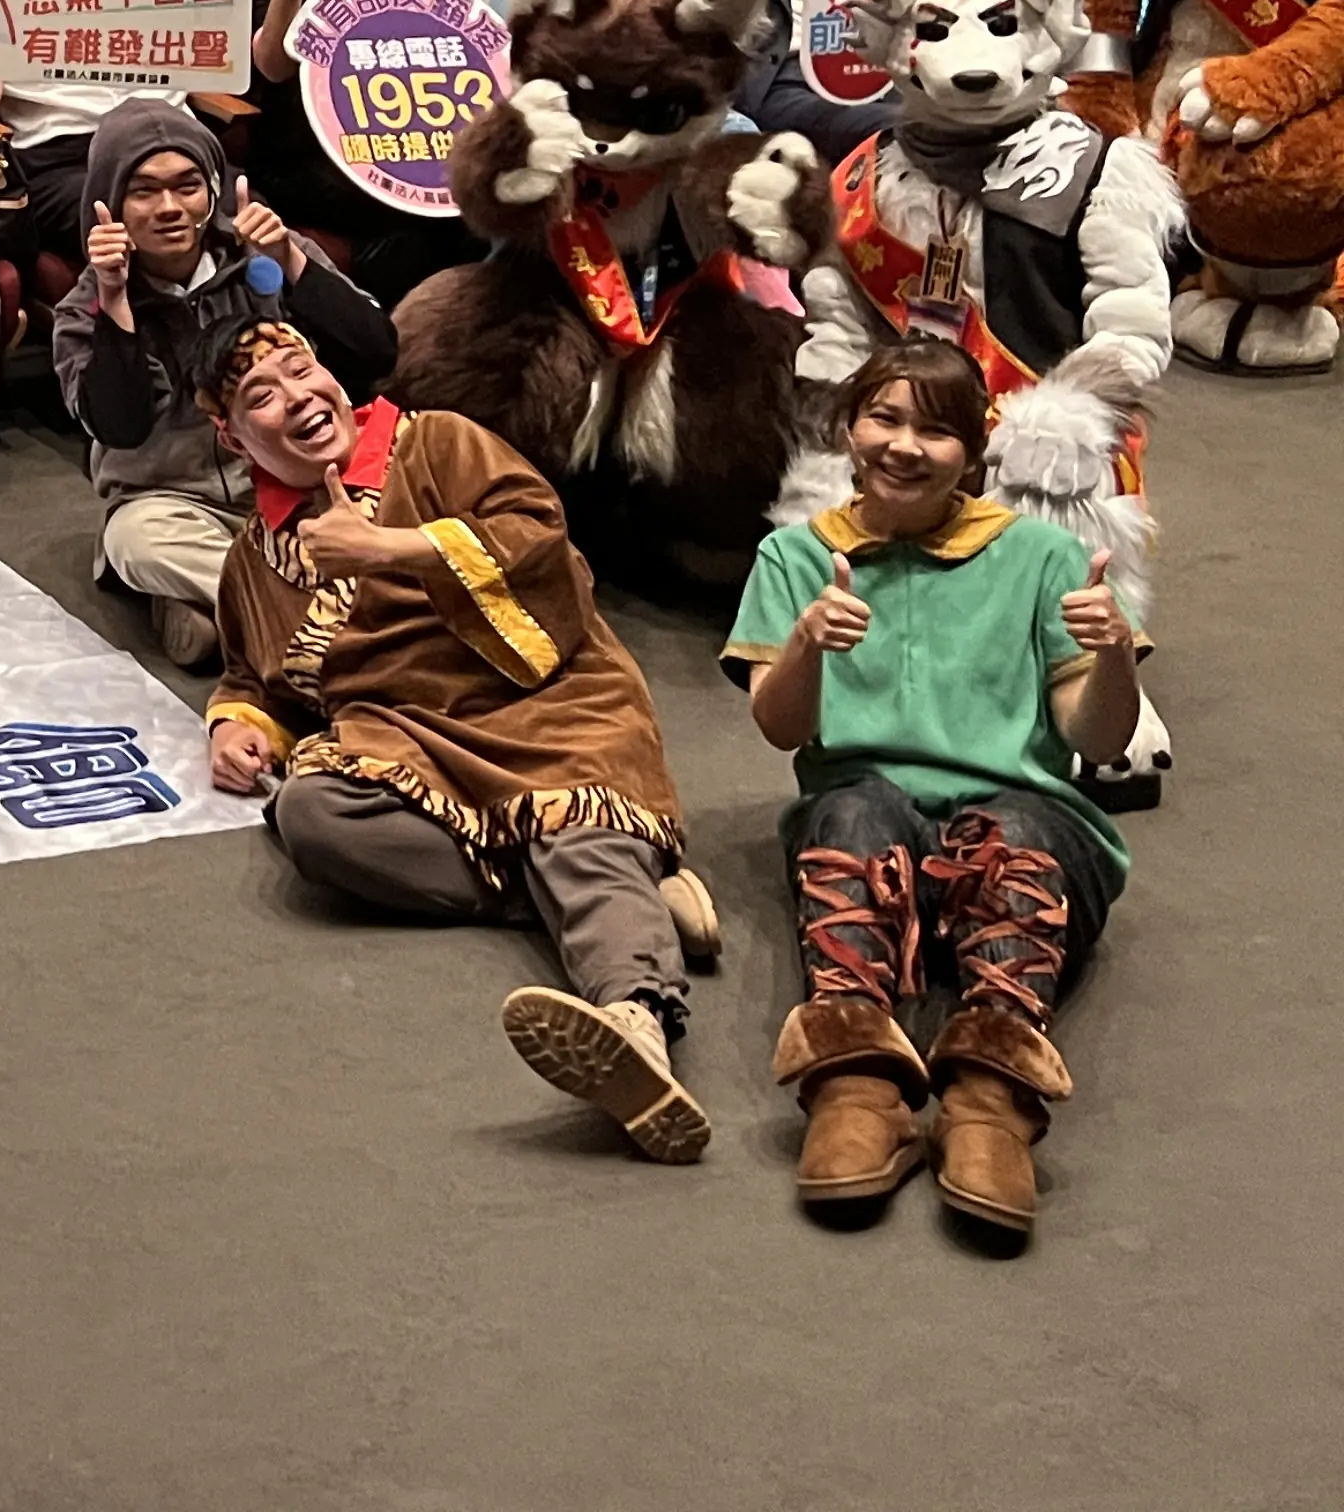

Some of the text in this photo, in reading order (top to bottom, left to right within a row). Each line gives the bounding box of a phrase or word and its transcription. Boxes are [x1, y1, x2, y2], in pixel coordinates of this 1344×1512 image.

[23, 27, 228, 67] 有難發出聲
[345, 36, 468, 70] 專線電話
[341, 70, 494, 129] 1953
